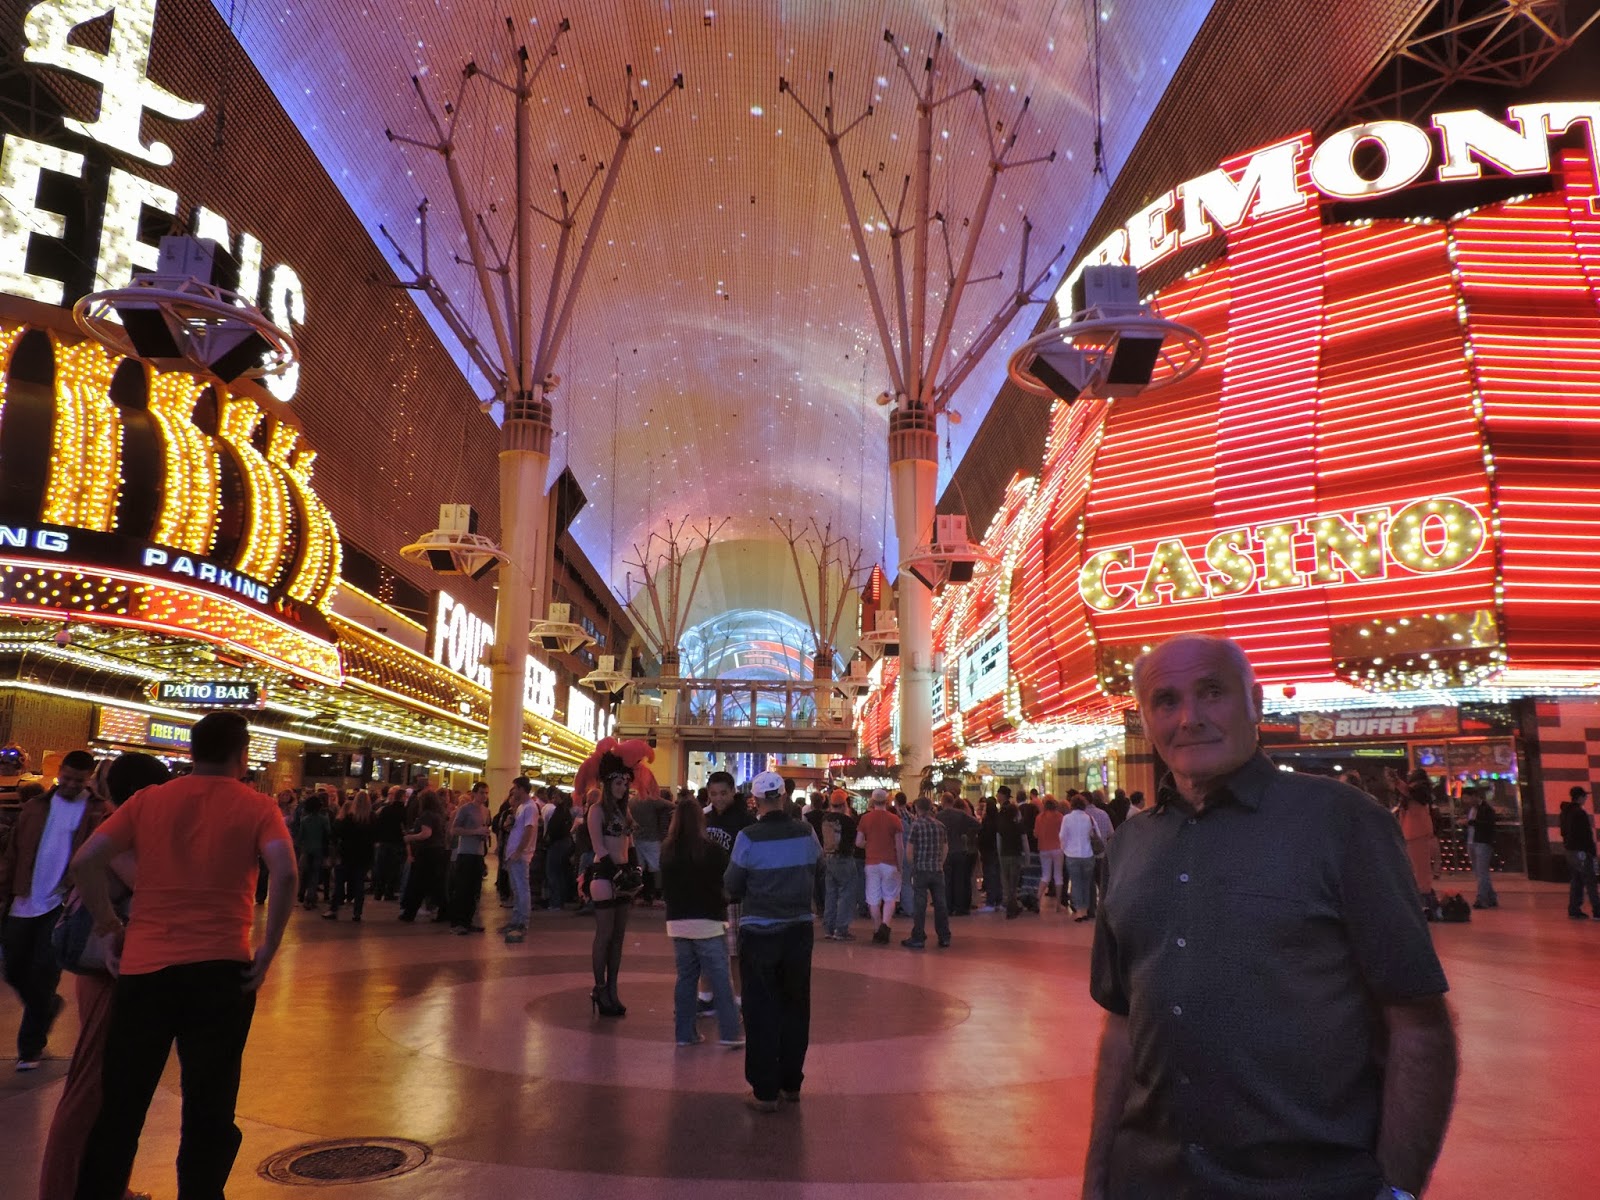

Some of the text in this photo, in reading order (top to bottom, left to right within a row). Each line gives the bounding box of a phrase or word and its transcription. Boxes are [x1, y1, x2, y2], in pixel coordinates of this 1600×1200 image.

[1078, 496, 1487, 613] CASINO
[143, 548, 270, 605] PARKING
[163, 683, 250, 700] PATIO BAR
[151, 723, 173, 740] FREE
[1335, 716, 1418, 737] BUFFET
